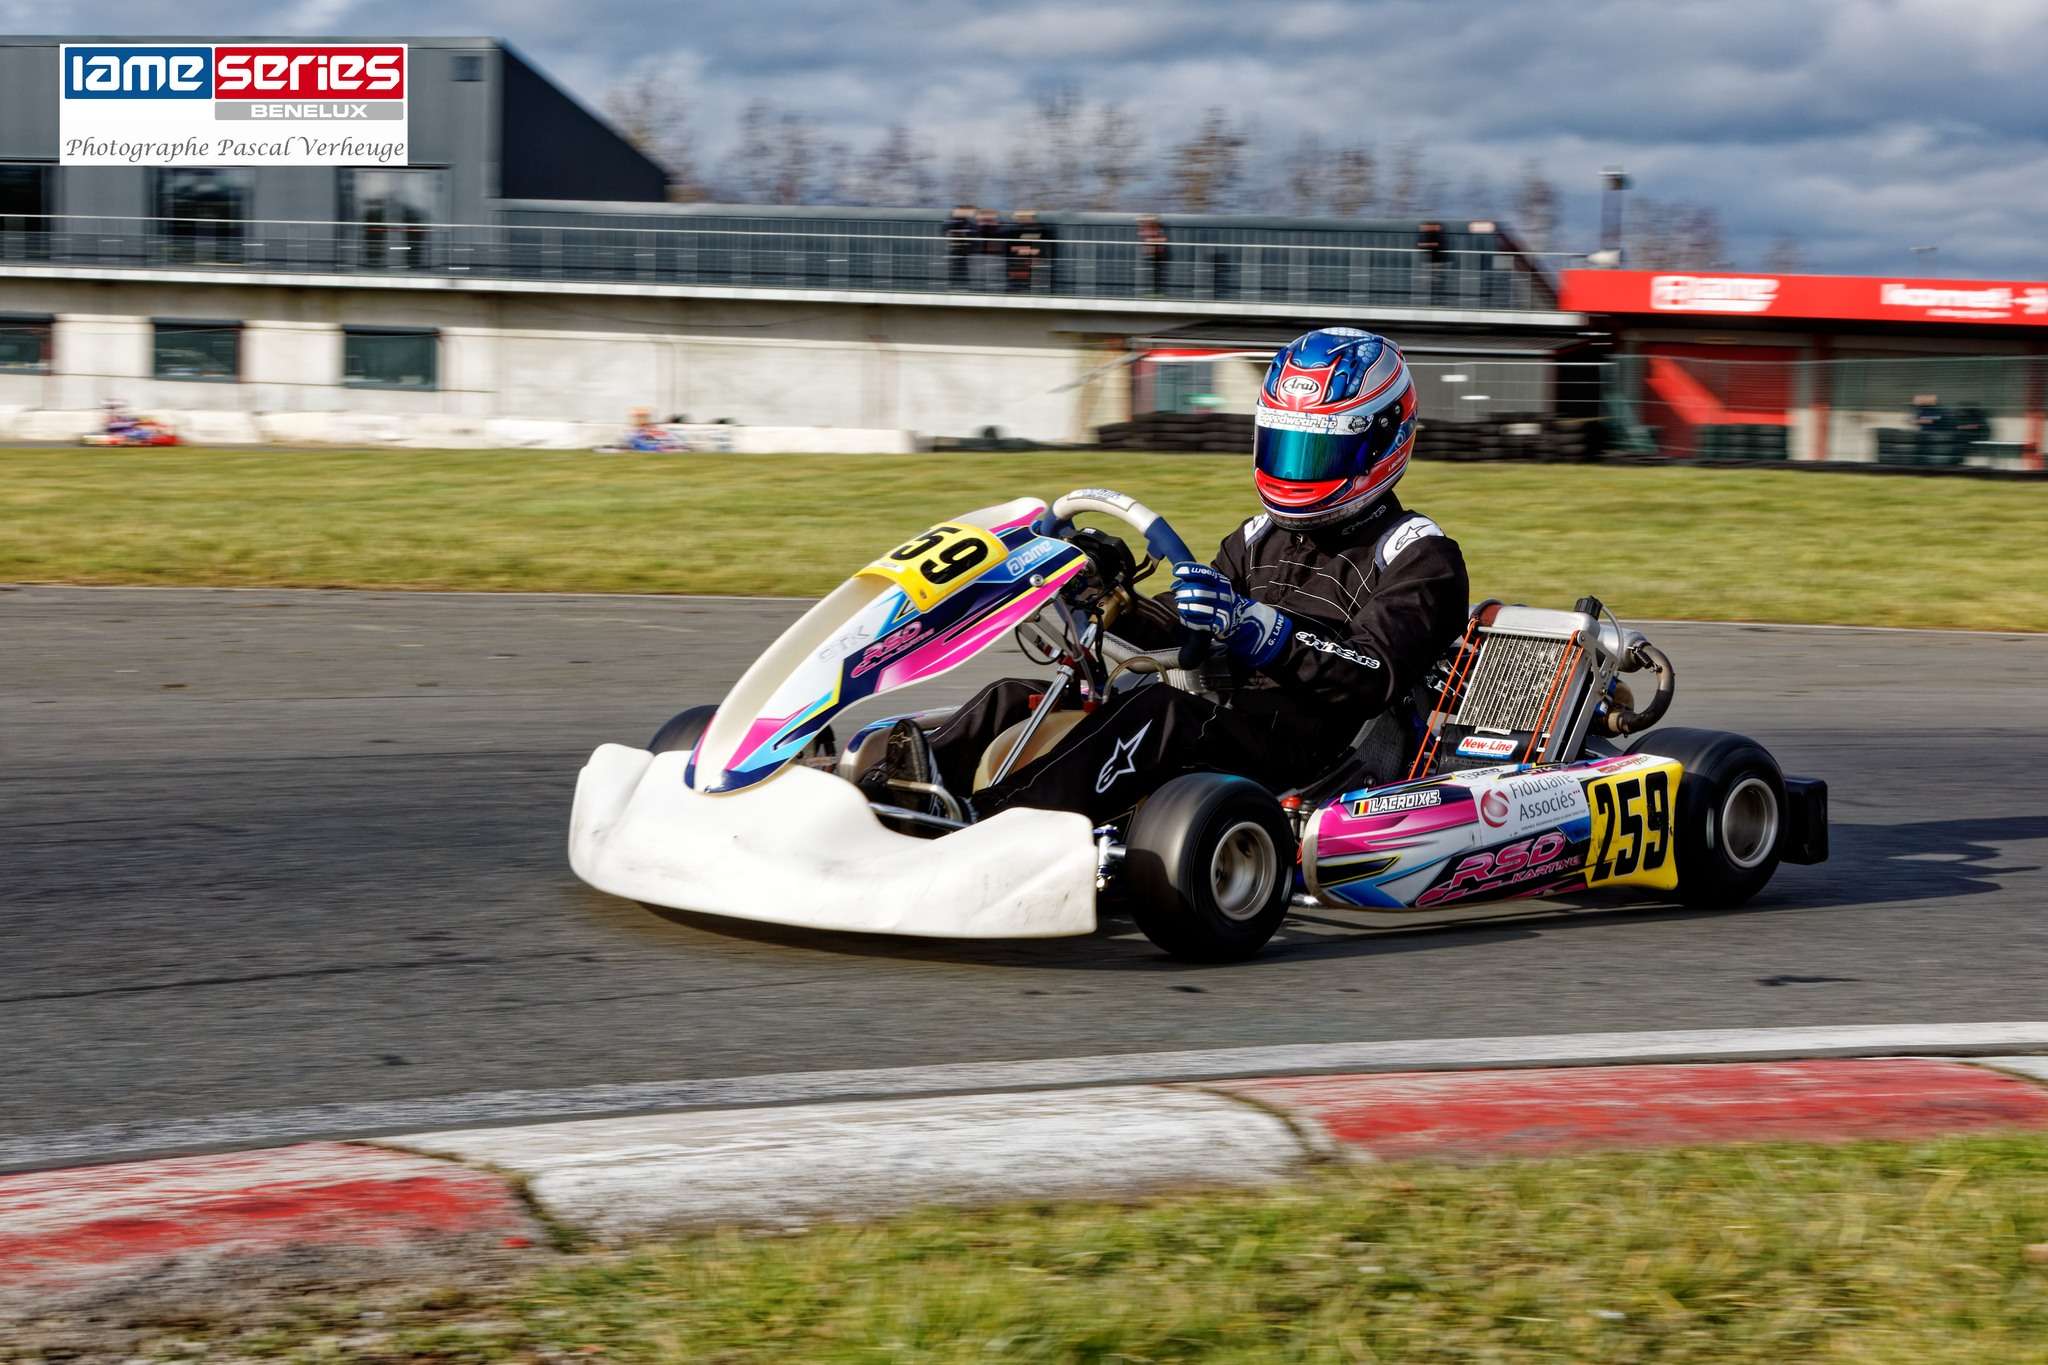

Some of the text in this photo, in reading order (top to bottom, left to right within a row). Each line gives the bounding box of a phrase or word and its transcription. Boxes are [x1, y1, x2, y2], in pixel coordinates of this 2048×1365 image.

[1285, 378, 1315, 391] Arai
[1462, 738, 1513, 752] New-Line
[1509, 774, 1574, 799] Fiduciaire
[1371, 791, 1428, 812] LACROIX
[1519, 790, 1577, 821] Associés
[1591, 770, 1670, 882] 259
[1450, 831, 1567, 889] RSD
[1512, 855, 1582, 883] KARTING
